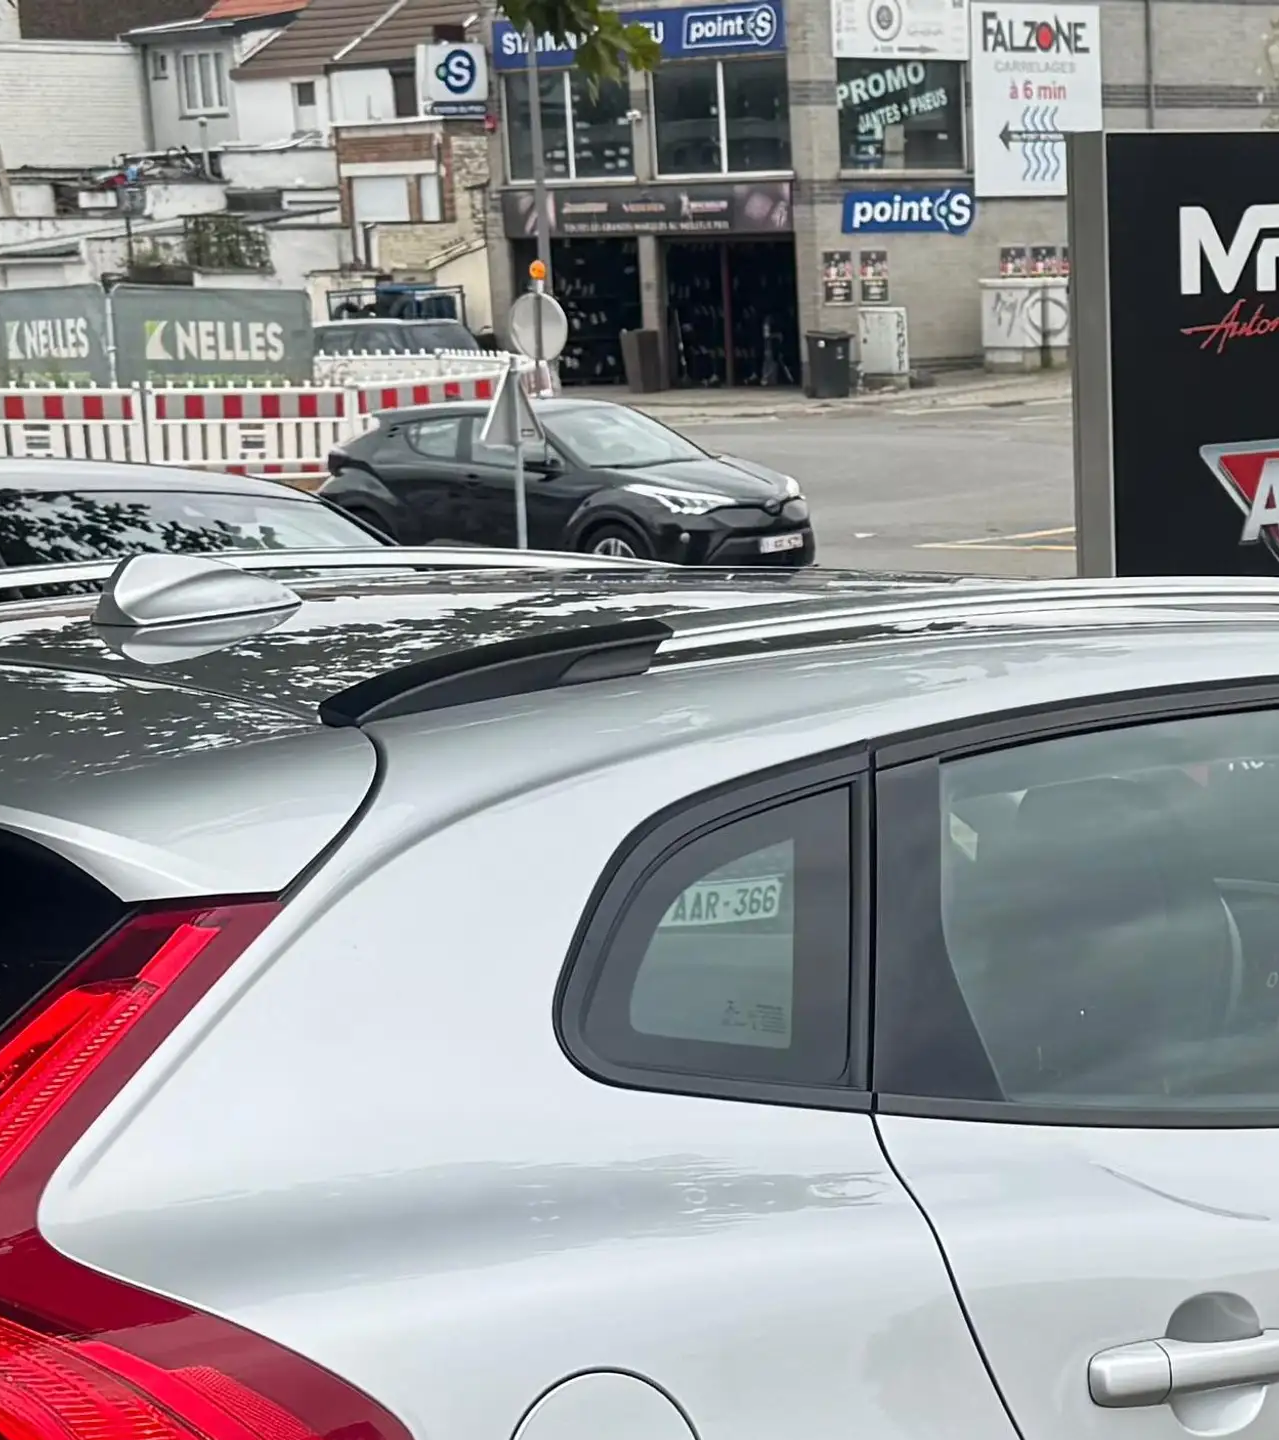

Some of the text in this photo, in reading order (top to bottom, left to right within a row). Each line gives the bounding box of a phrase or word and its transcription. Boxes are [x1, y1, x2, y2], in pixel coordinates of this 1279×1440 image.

[690, 14, 747, 43] point
[982, 11, 1090, 55] FALZONE
[836, 61, 925, 110] PROMO
[994, 60, 1077, 74] CARRELAGES
[1009, 77, 1067, 100] à 6 min
[852, 194, 933, 228] point
[23, 317, 89, 359] NELLES
[175, 320, 285, 362] NELLES
